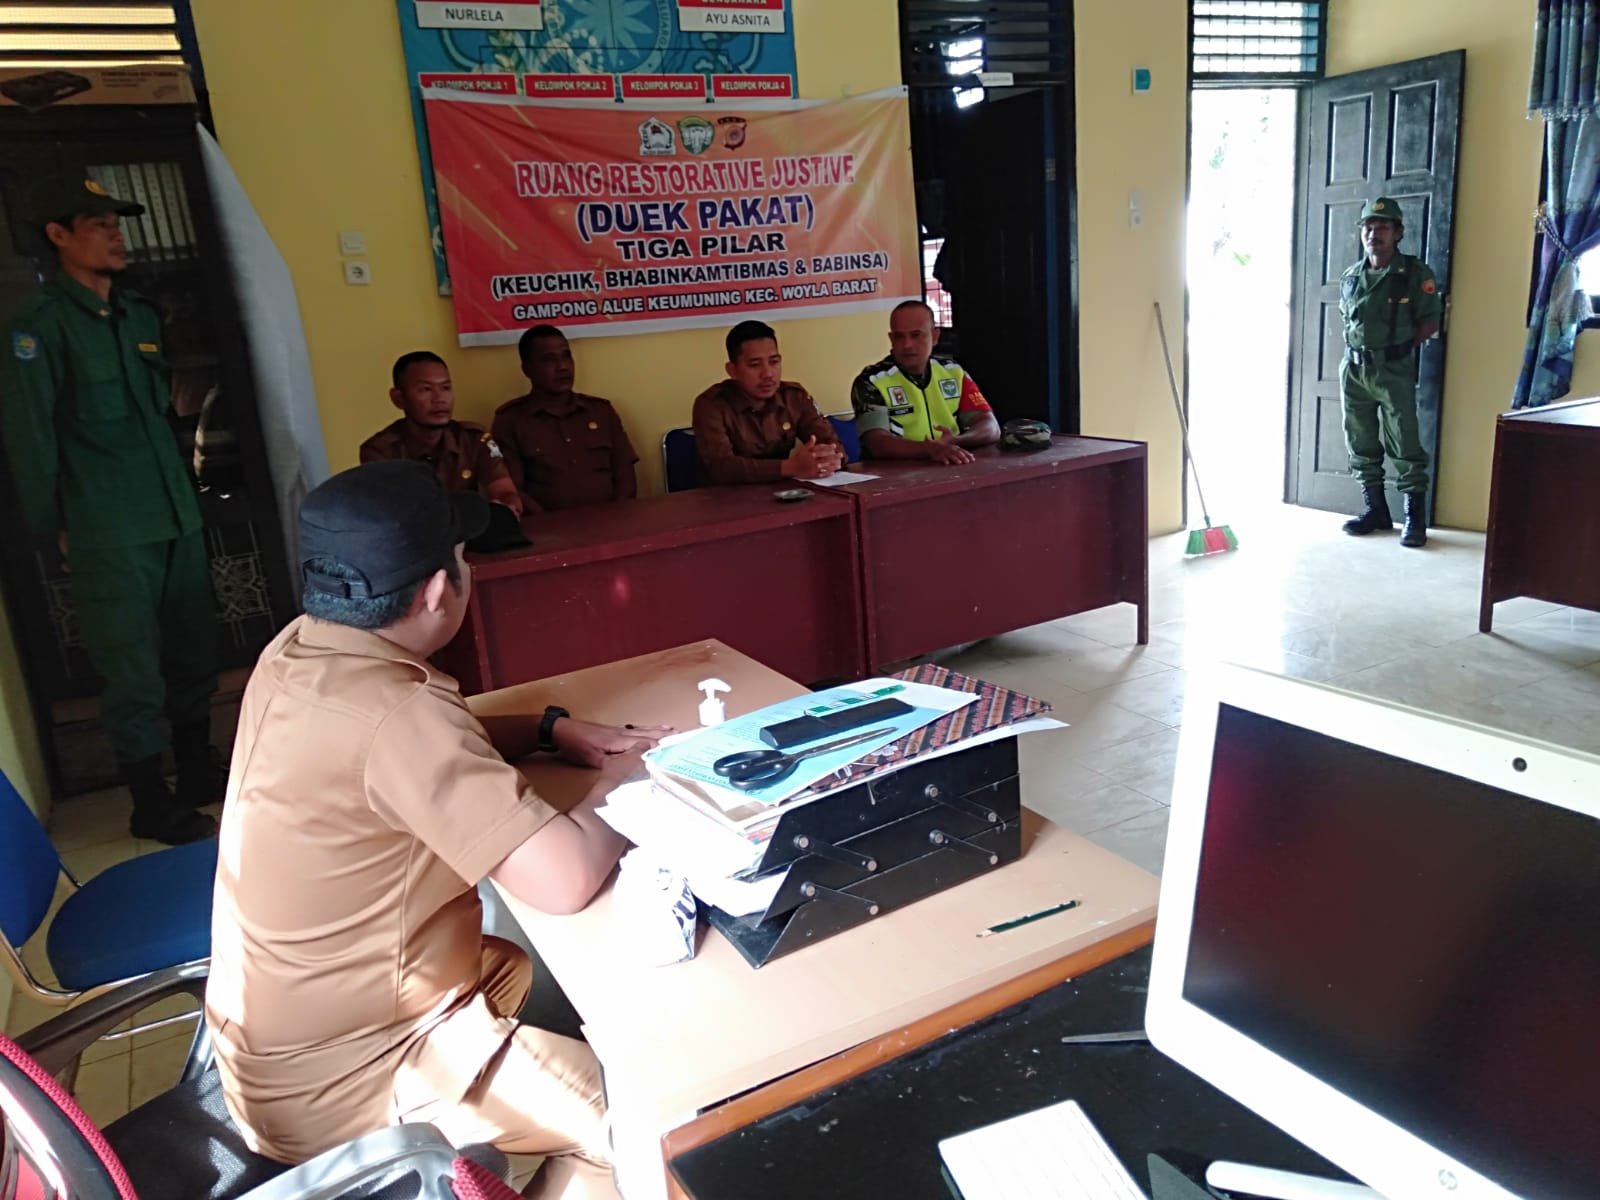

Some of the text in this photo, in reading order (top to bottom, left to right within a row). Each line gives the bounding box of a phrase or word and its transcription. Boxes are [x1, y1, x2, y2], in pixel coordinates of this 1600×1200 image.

[445, 8, 504, 21] NURLELA
[705, 13, 771, 26] AYU ASNITA
[602, 81, 608, 91] 2
[694, 81, 699, 90] 3
[780, 81, 785, 90] 4
[516, 154, 854, 196] RUANG RESTORATIVE JUSTIVE
[577, 194, 814, 243] (DUEK PAKAT)
[616, 232, 785, 260] TIGA PILAR
[492, 252, 889, 300] (KEUCHIK, BHABINKAMTIBMAS & BABINSA)
[514, 279, 877, 320] GAMPONG ALUE KEUMUNING KEC. WOYLA BARAT
